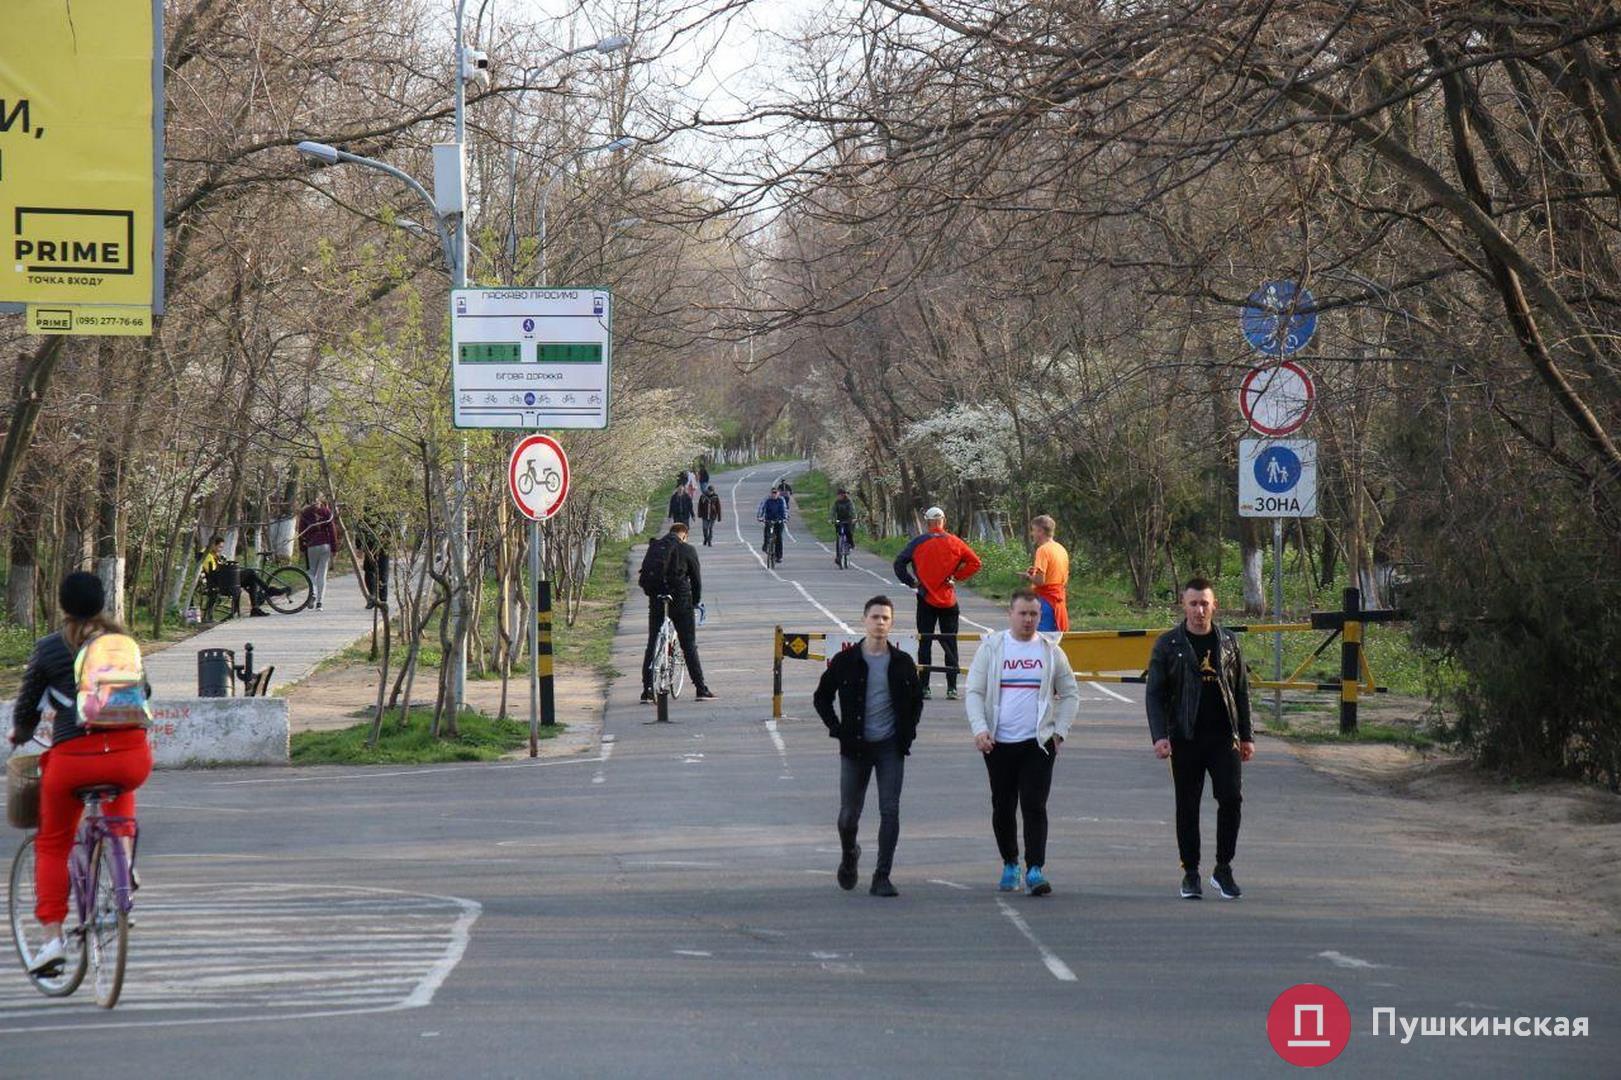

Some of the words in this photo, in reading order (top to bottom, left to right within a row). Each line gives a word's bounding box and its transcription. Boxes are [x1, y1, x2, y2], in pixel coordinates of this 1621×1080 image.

[15, 239, 120, 263] PRIME
[28, 276, 65, 285] ТОЧКА
[67, 277, 104, 286] ВХОДУ
[530, 291, 578, 300] ПРОСИМО
[36, 319, 68, 327] PRIME
[75, 317, 98, 326] (095)
[100, 317, 144, 327] 277-76-66
[1254, 496, 1301, 512] ЗОНА
[1003, 659, 1043, 669] NASA
